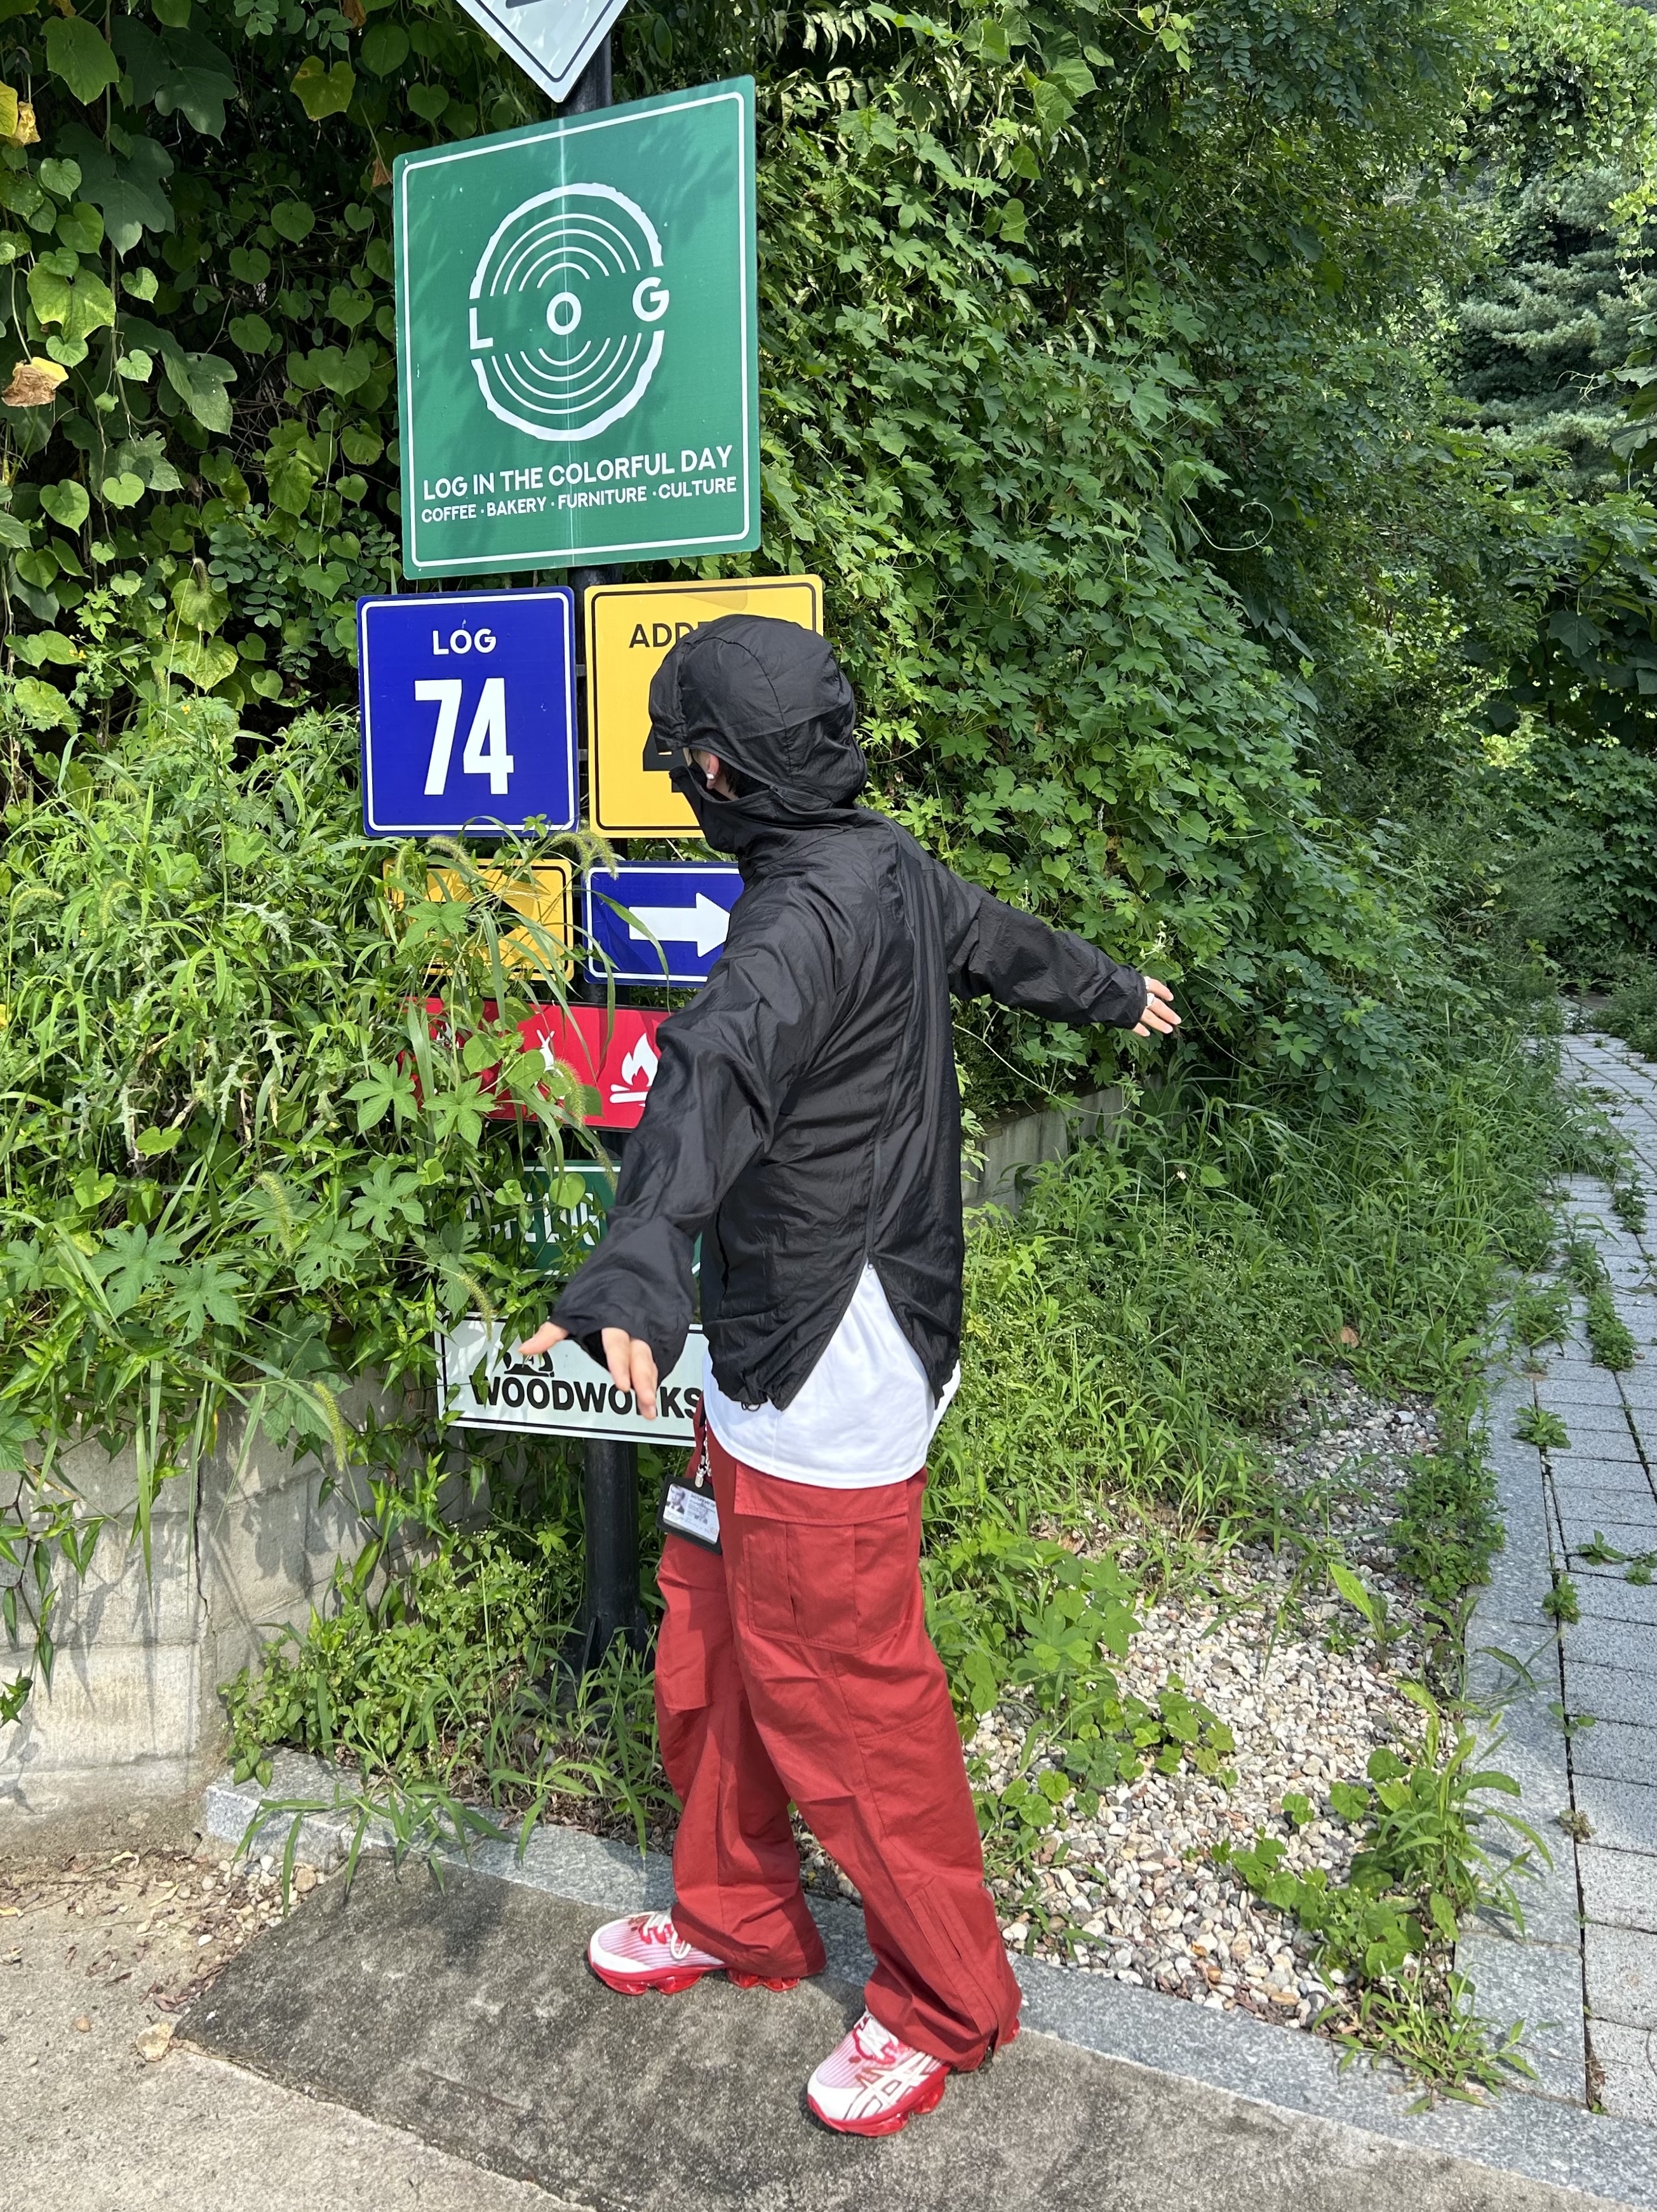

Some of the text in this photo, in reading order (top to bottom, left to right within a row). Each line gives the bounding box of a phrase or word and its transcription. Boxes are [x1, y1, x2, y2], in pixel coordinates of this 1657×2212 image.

[424, 445, 733, 500] LOG IN THE COLORFUL DAY
[421, 504, 477, 523] COFFEE
[558, 486, 647, 510] FURNITURE
[433, 628, 497, 655] LOG
[414, 678, 514, 795] 74
[469, 1374, 704, 1419] WOODWOKS
